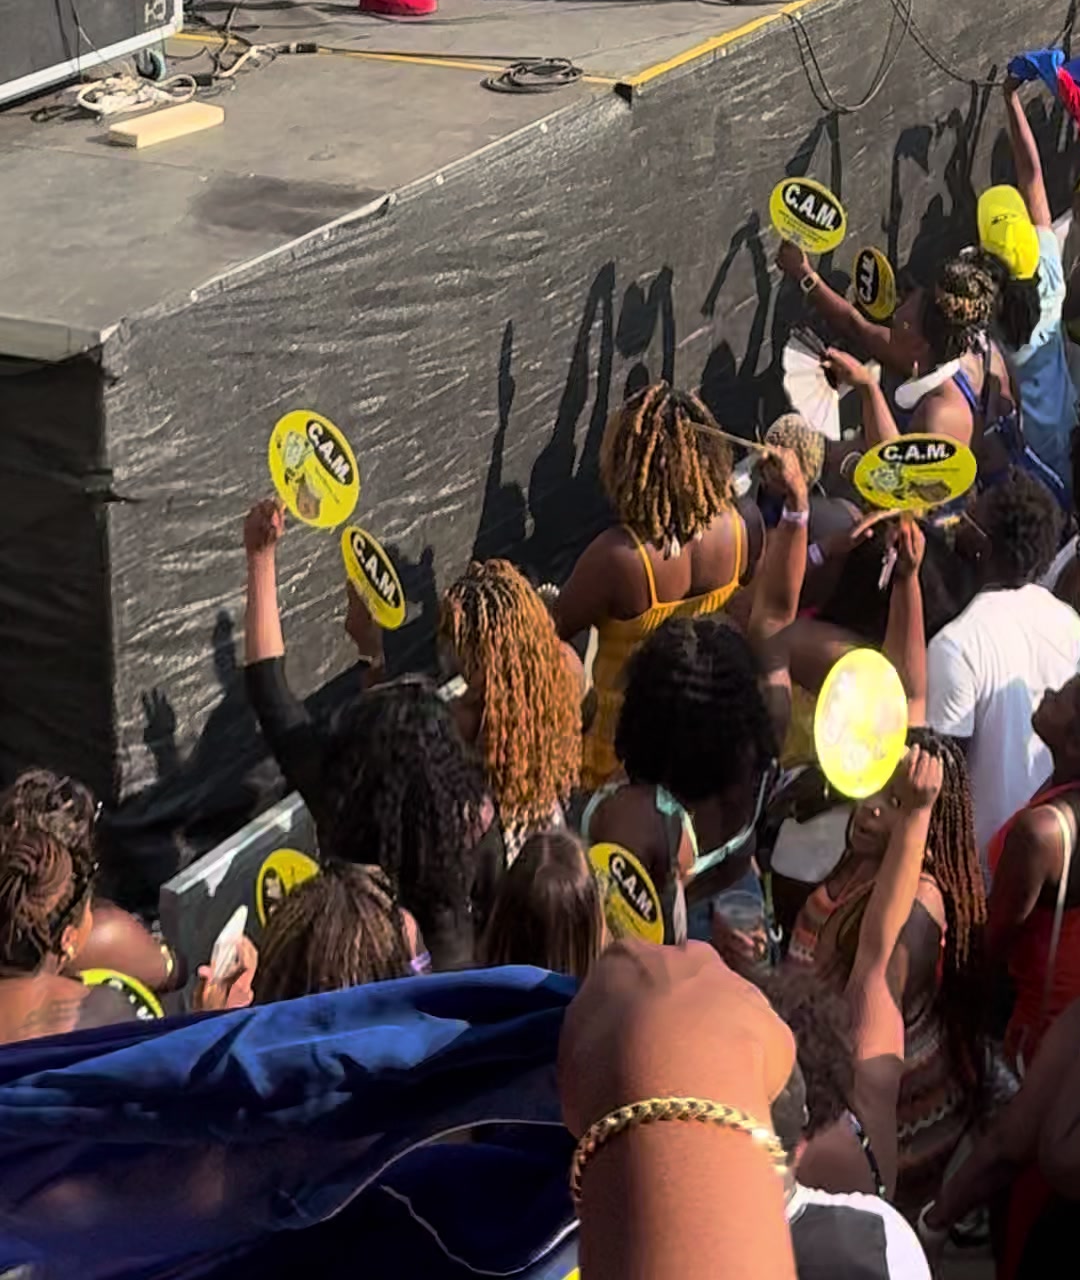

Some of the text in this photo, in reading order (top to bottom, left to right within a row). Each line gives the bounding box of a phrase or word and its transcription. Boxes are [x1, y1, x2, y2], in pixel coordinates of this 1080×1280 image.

[784, 183, 837, 231] C.A.M.
[308, 422, 352, 485] C.A.M.
[884, 443, 950, 461] C.A.M.
[353, 533, 397, 608] C.A.M.
